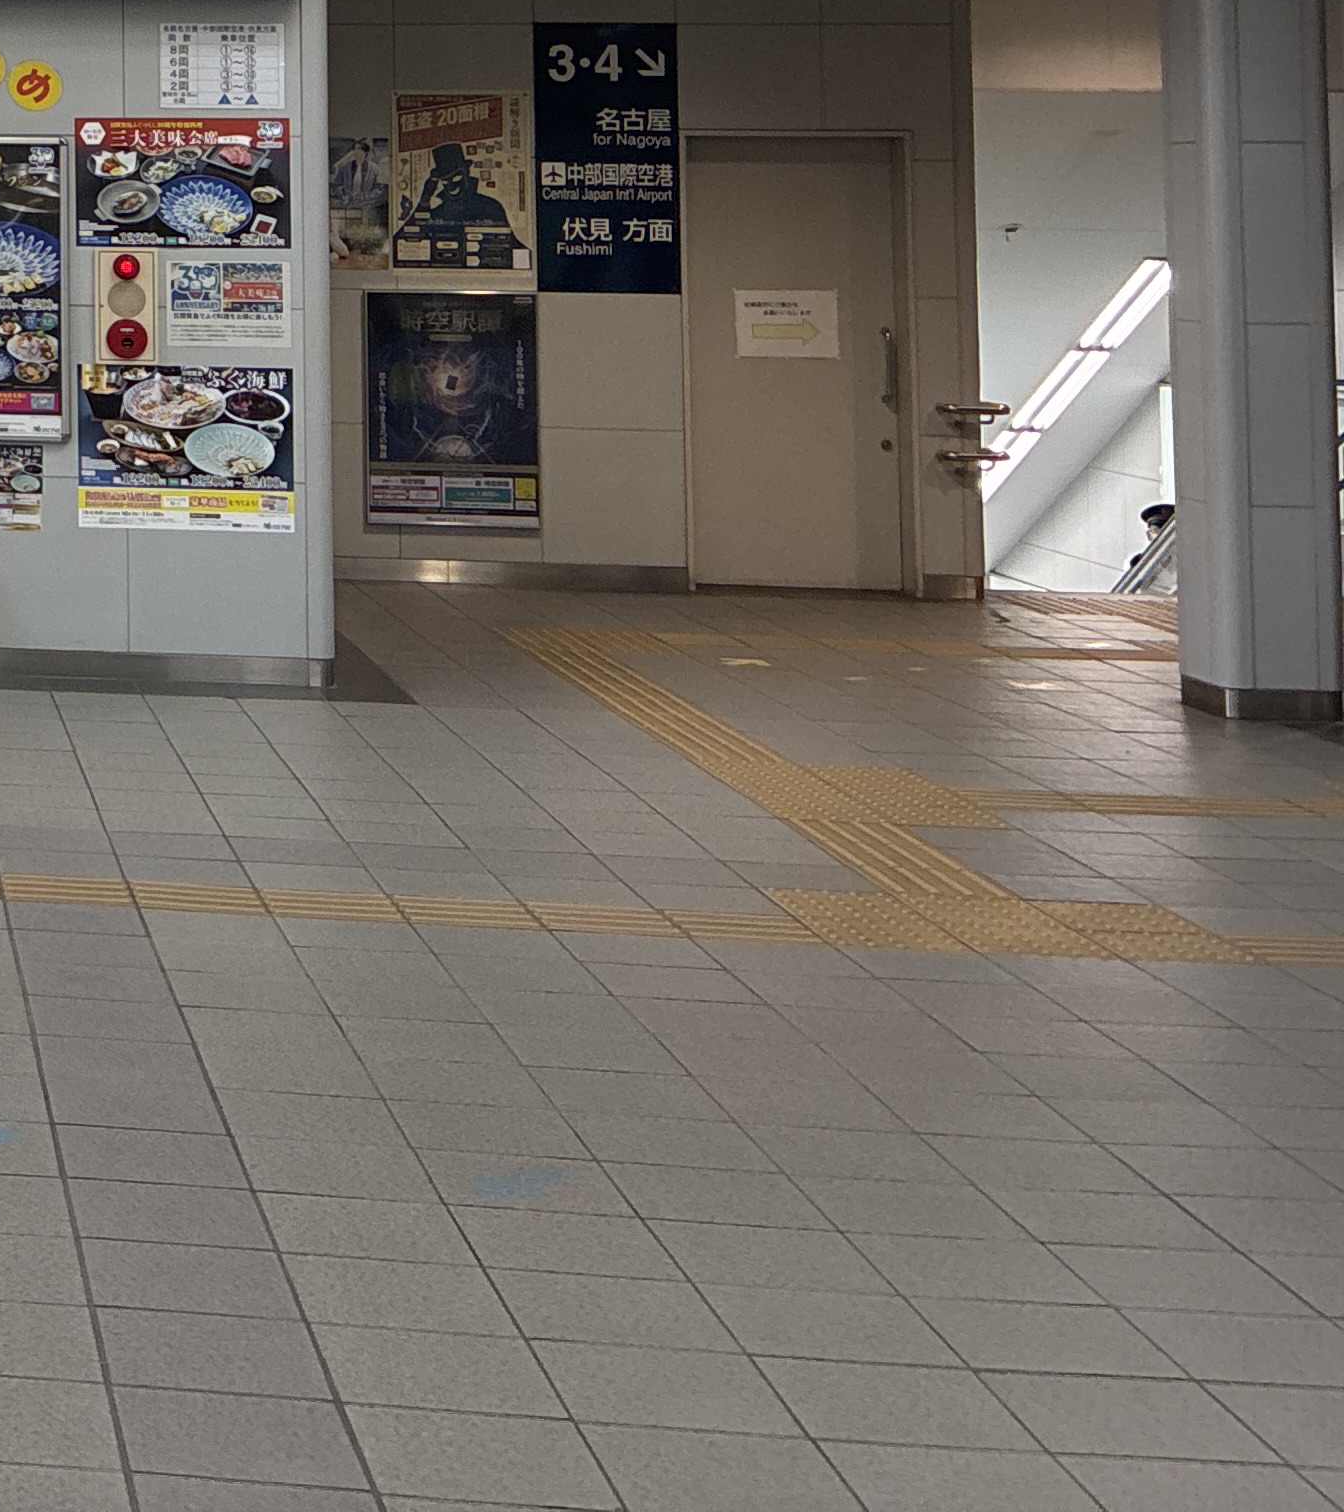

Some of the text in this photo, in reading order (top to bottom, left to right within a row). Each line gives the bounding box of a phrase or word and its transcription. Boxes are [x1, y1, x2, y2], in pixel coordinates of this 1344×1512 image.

[400, 111, 432, 133] 怪盗
[595, 108, 672, 132] 名古屋
[110, 129, 218, 147] 三大美味会席
[593, 133, 671, 148] for Nagoya
[567, 162, 673, 187] 中部国際空港
[542, 188, 581, 201] Central
[584, 188, 613, 203] Japan
[636, 188, 673, 203] Airport
[562, 217, 673, 243] 伏見 方面
[556, 242, 612, 256] Fushimi
